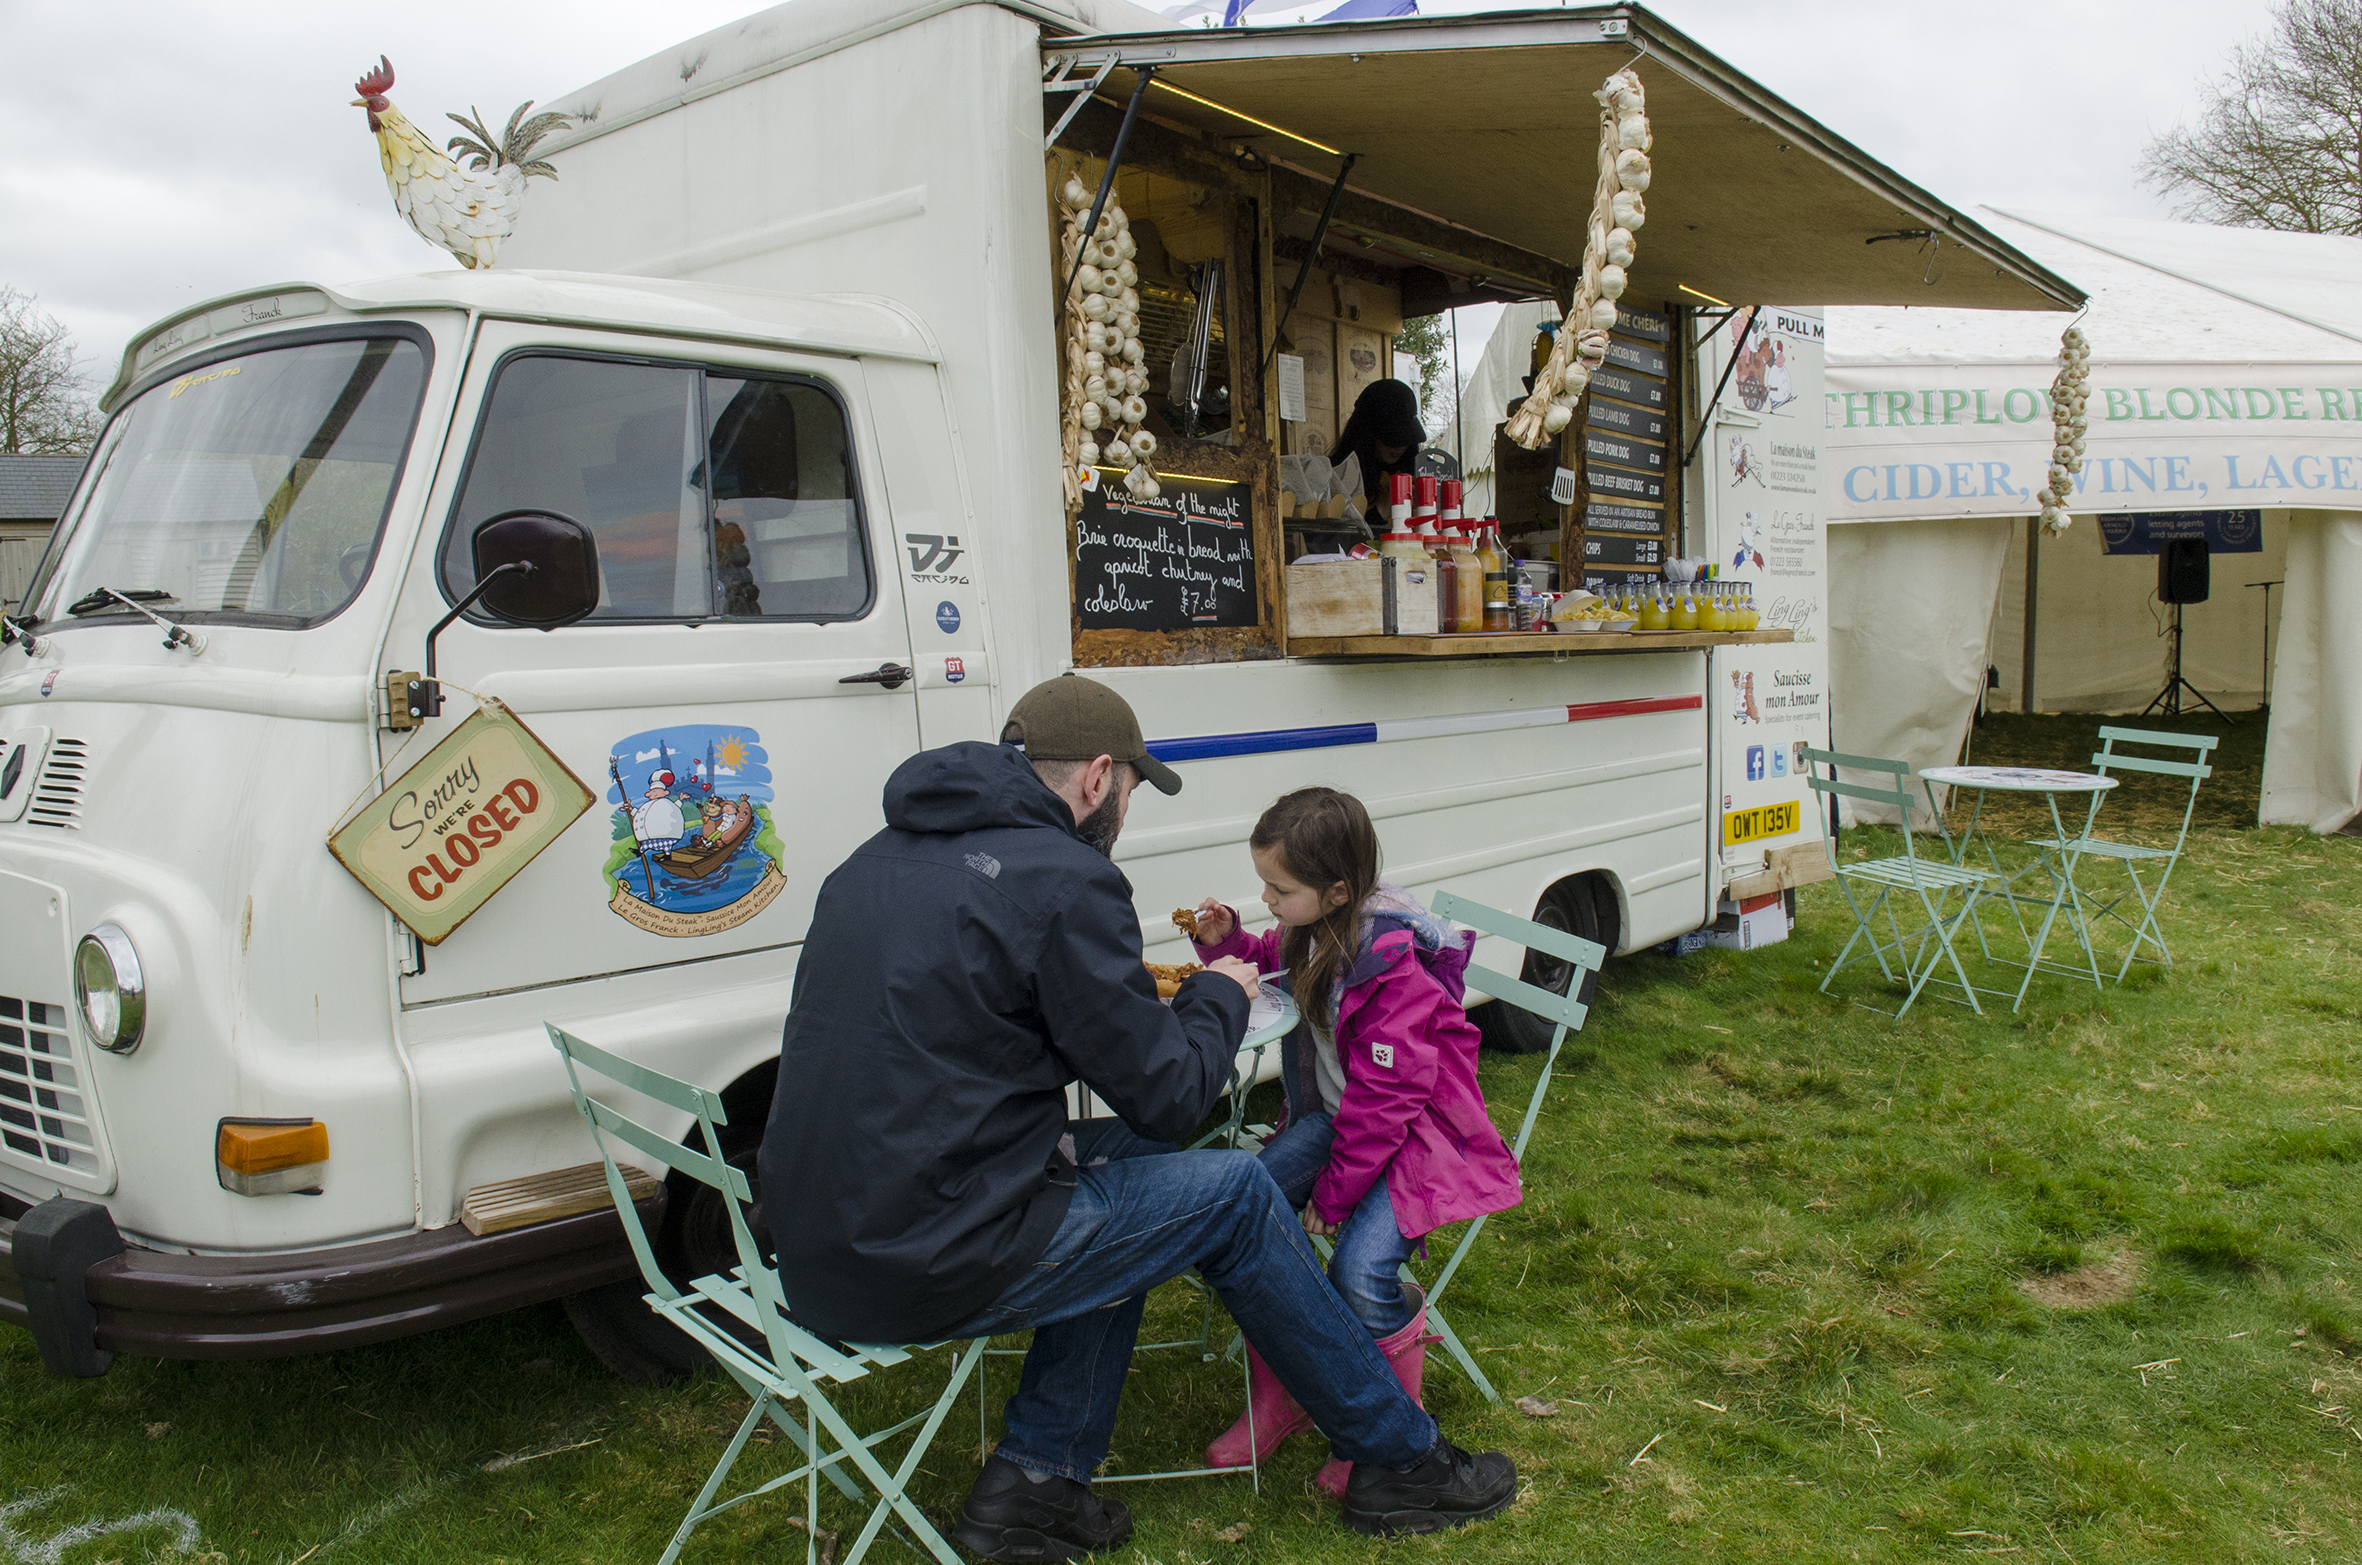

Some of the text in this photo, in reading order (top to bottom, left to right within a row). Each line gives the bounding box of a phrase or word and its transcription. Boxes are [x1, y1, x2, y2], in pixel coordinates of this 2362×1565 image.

[241, 297, 283, 323] Franck
[1777, 316, 1809, 336] PULL
[1610, 343, 1630, 359] CHICKEN
[1630, 349, 1640, 363] DOG
[1606, 375, 1620, 389] DUCK
[1620, 380, 1631, 393] DOG
[2100, 386, 2309, 421] BLONDE
[1588, 405, 1605, 420] PULLED
[1605, 409, 1619, 423] LAMB
[1618, 412, 1630, 426] DOG
[1587, 439, 1660, 465] PULLED PORK DOG £7.00
[1777, 443, 1795, 458] maison
[1802, 445, 1816, 460] Steak
[1587, 472, 1660, 496] PULLED BEEF BRISKET DOG £7.00
[1843, 461, 2030, 505] CIDER,
[2222, 454, 2362, 490] LAGE
[1176, 492, 1188, 525] of
[1189, 492, 1206, 515] the
[1209, 497, 1239, 529] night
[2228, 510, 2246, 524] 25
[1795, 513, 1815, 532] Franck
[2148, 520, 2205, 529] letting agents
[1076, 520, 1253, 566] Brie croquette in bread with
[2149, 531, 2166, 539] and
[1585, 541, 1602, 555] CHIPS
[1104, 551, 1245, 602] apricot chutney and
[1084, 583, 1153, 613] coleslaw
[1766, 595, 1790, 628] Ling
[947, 660, 961, 672] GT
[1774, 669, 1812, 688] Saucisse
[1765, 690, 1820, 709] mon Amour
[1764, 714, 1785, 724] Specialists
[1792, 713, 1804, 722] event
[1804, 711, 1821, 722] catering
[389, 755, 480, 850] Sorry
[433, 799, 475, 836] WE'RE
[1733, 805, 1792, 839] OWT 135V
[408, 778, 540, 901] CLOSED
[963, 853, 992, 867] NORTH
[965, 860, 986, 872] FACE
[978, 851, 994, 861] THE
[622, 896, 633, 907] La
[634, 903, 660, 921] Maison
[662, 914, 674, 923] Du
[706, 909, 735, 924] Saussice
[736, 899, 752, 912] Mon
[752, 876, 774, 899] Amour
[618, 904, 628, 915] Le
[629, 913, 648, 926] Gros
[650, 923, 678, 934] Franck
[687, 921, 727, 937] LingLing's
[729, 908, 753, 925] Steam
